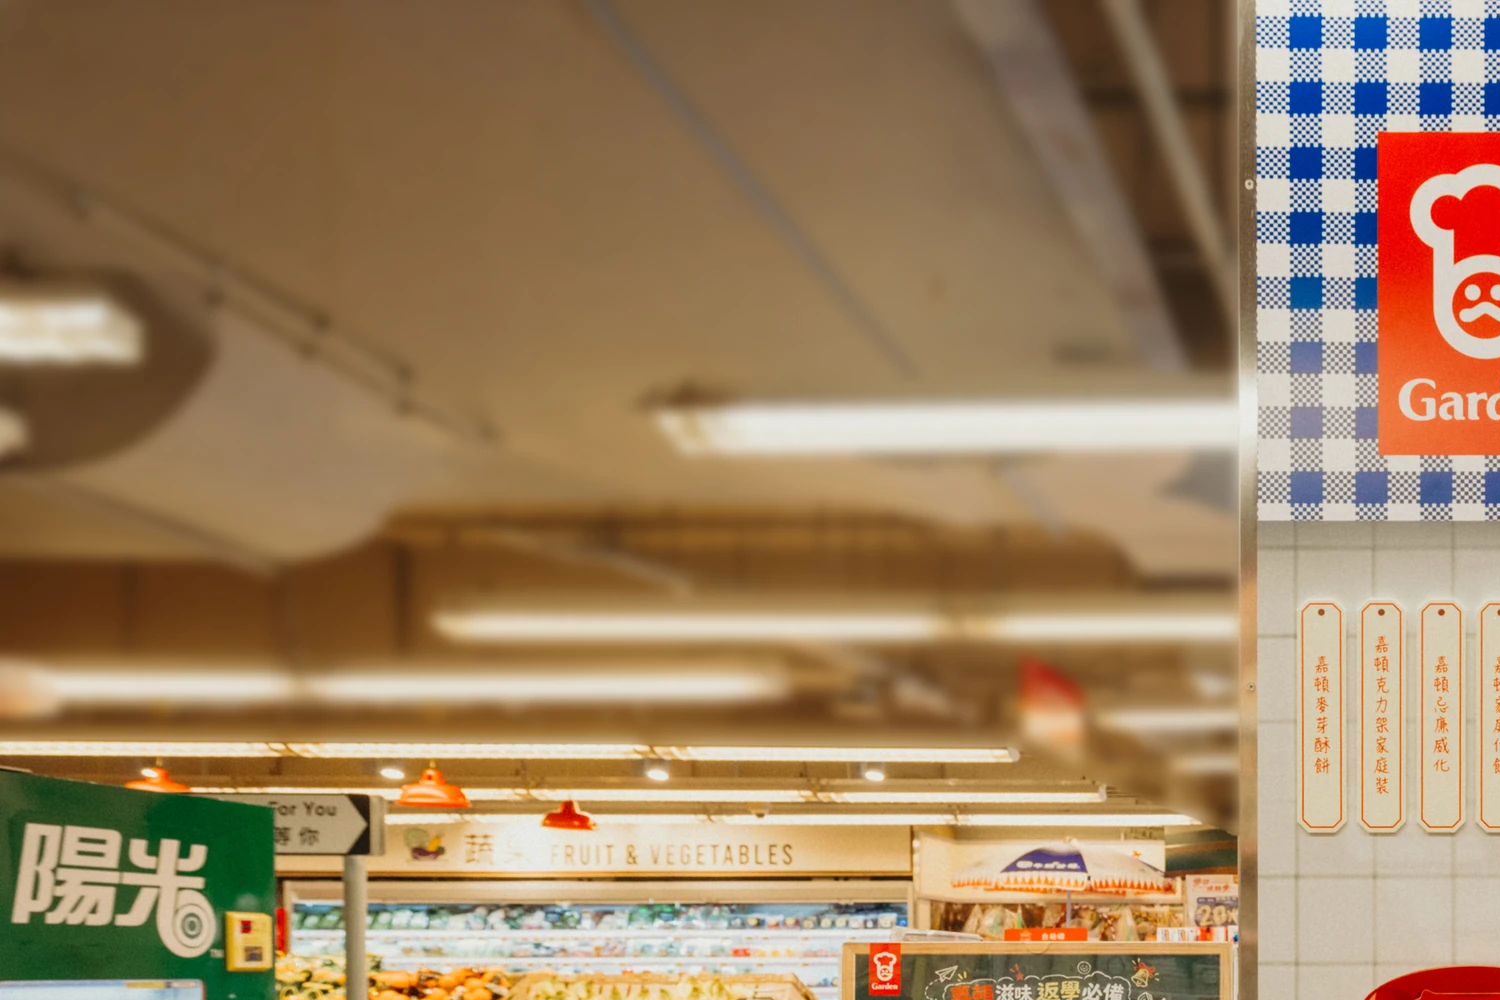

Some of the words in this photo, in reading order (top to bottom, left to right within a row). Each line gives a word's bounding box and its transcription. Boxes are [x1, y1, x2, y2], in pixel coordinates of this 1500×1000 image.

[1313, 655, 1331, 775] 嘉頓麥芽酥餅
[1433, 655, 1450, 773] 嘉頓忌廉威化
[302, 801, 338, 817] You
[11, 821, 218, 958] 陽光
[551, 844, 615, 867] FRUIT
[626, 844, 639, 866] &
[650, 843, 794, 867] VEGETABLES
[871, 983, 899, 991] Garden
